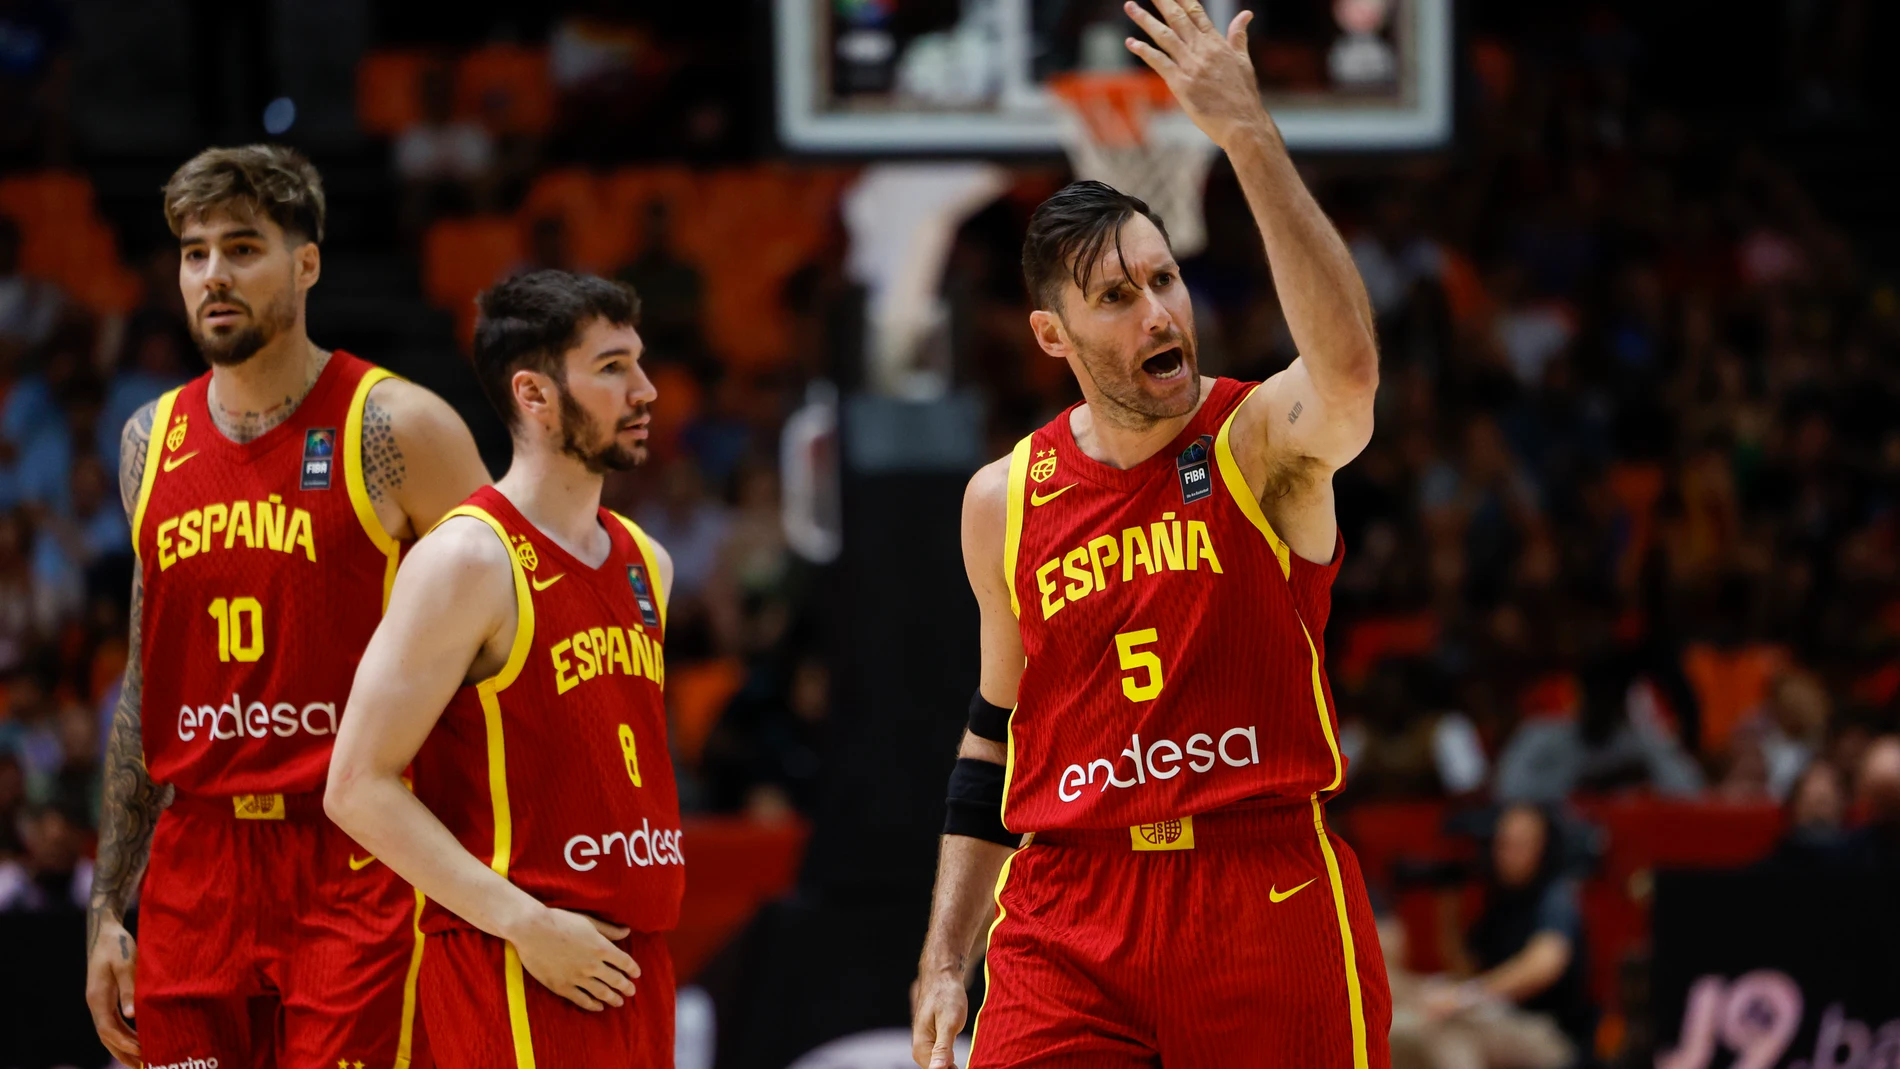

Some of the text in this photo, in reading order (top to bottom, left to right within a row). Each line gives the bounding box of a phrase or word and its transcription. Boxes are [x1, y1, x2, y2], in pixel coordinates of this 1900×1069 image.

[1184, 467, 1206, 485] FIBA
[157, 494, 317, 572] ESPAÑA
[1036, 512, 1224, 621] ESPAÑA
[207, 597, 265, 662] 10
[550, 623, 665, 696] ESPAÑA
[1115, 627, 1164, 703] 5
[178, 693, 338, 742] endesa
[618, 723, 642, 788] 8
[1058, 725, 1260, 803] endesa
